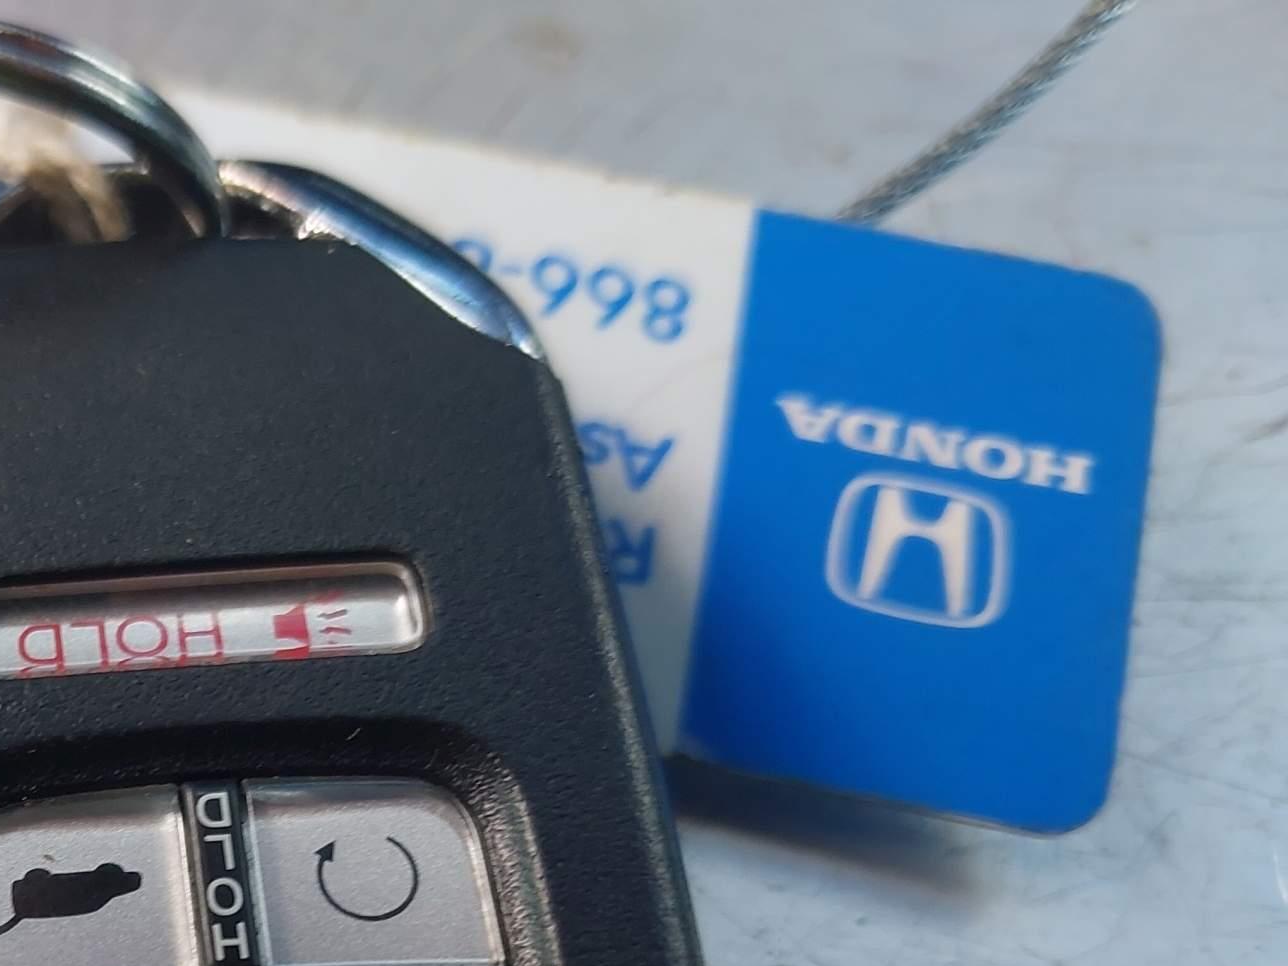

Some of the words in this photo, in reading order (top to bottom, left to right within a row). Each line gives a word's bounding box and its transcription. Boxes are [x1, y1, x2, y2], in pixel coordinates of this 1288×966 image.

[774, 393, 1095, 495] HONDA
[17, 611, 225, 677] HOLD
[196, 791, 251, 962] HOLD
